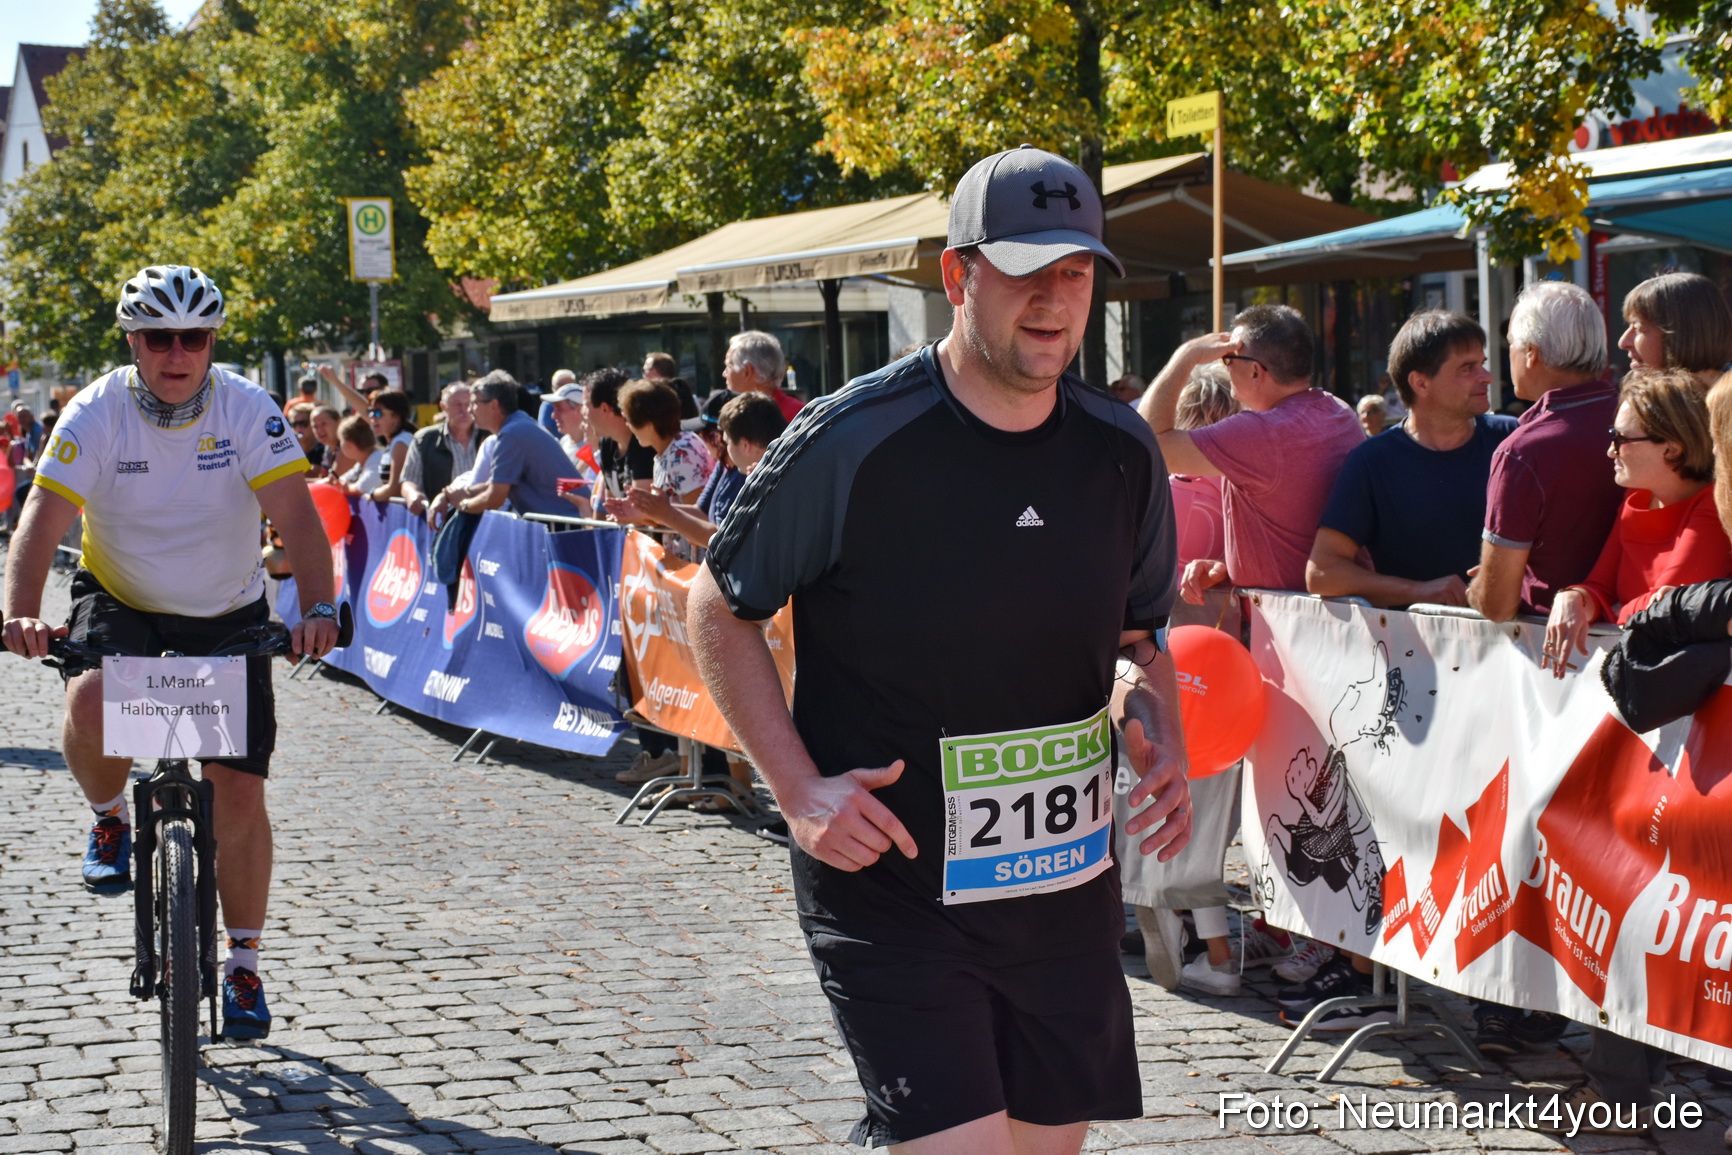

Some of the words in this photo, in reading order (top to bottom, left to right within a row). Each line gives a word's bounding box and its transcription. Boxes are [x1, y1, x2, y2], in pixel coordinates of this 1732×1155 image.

[1177, 106, 1215, 125] Toiletten
[46, 435, 78, 465] 20
[197, 436, 216, 452] 20
[1016, 519, 1044, 527] adidas
[649, 677, 699, 711] Agentur
[1177, 683, 1206, 696] nergie
[121, 702, 230, 716] Halbmarathon
[958, 720, 1105, 782] BOCK
[969, 773, 1101, 849] 2181
[1652, 795, 1669, 823] 1929
[1649, 823, 1659, 845] Seit
[994, 844, 1086, 882] SÖREN
[1522, 828, 1611, 957] Braun
[1471, 918, 1489, 937] Sicher
[1486, 909, 1496, 923] ist
[1553, 917, 1573, 949] Sicher
[1572, 943, 1584, 961] ist
